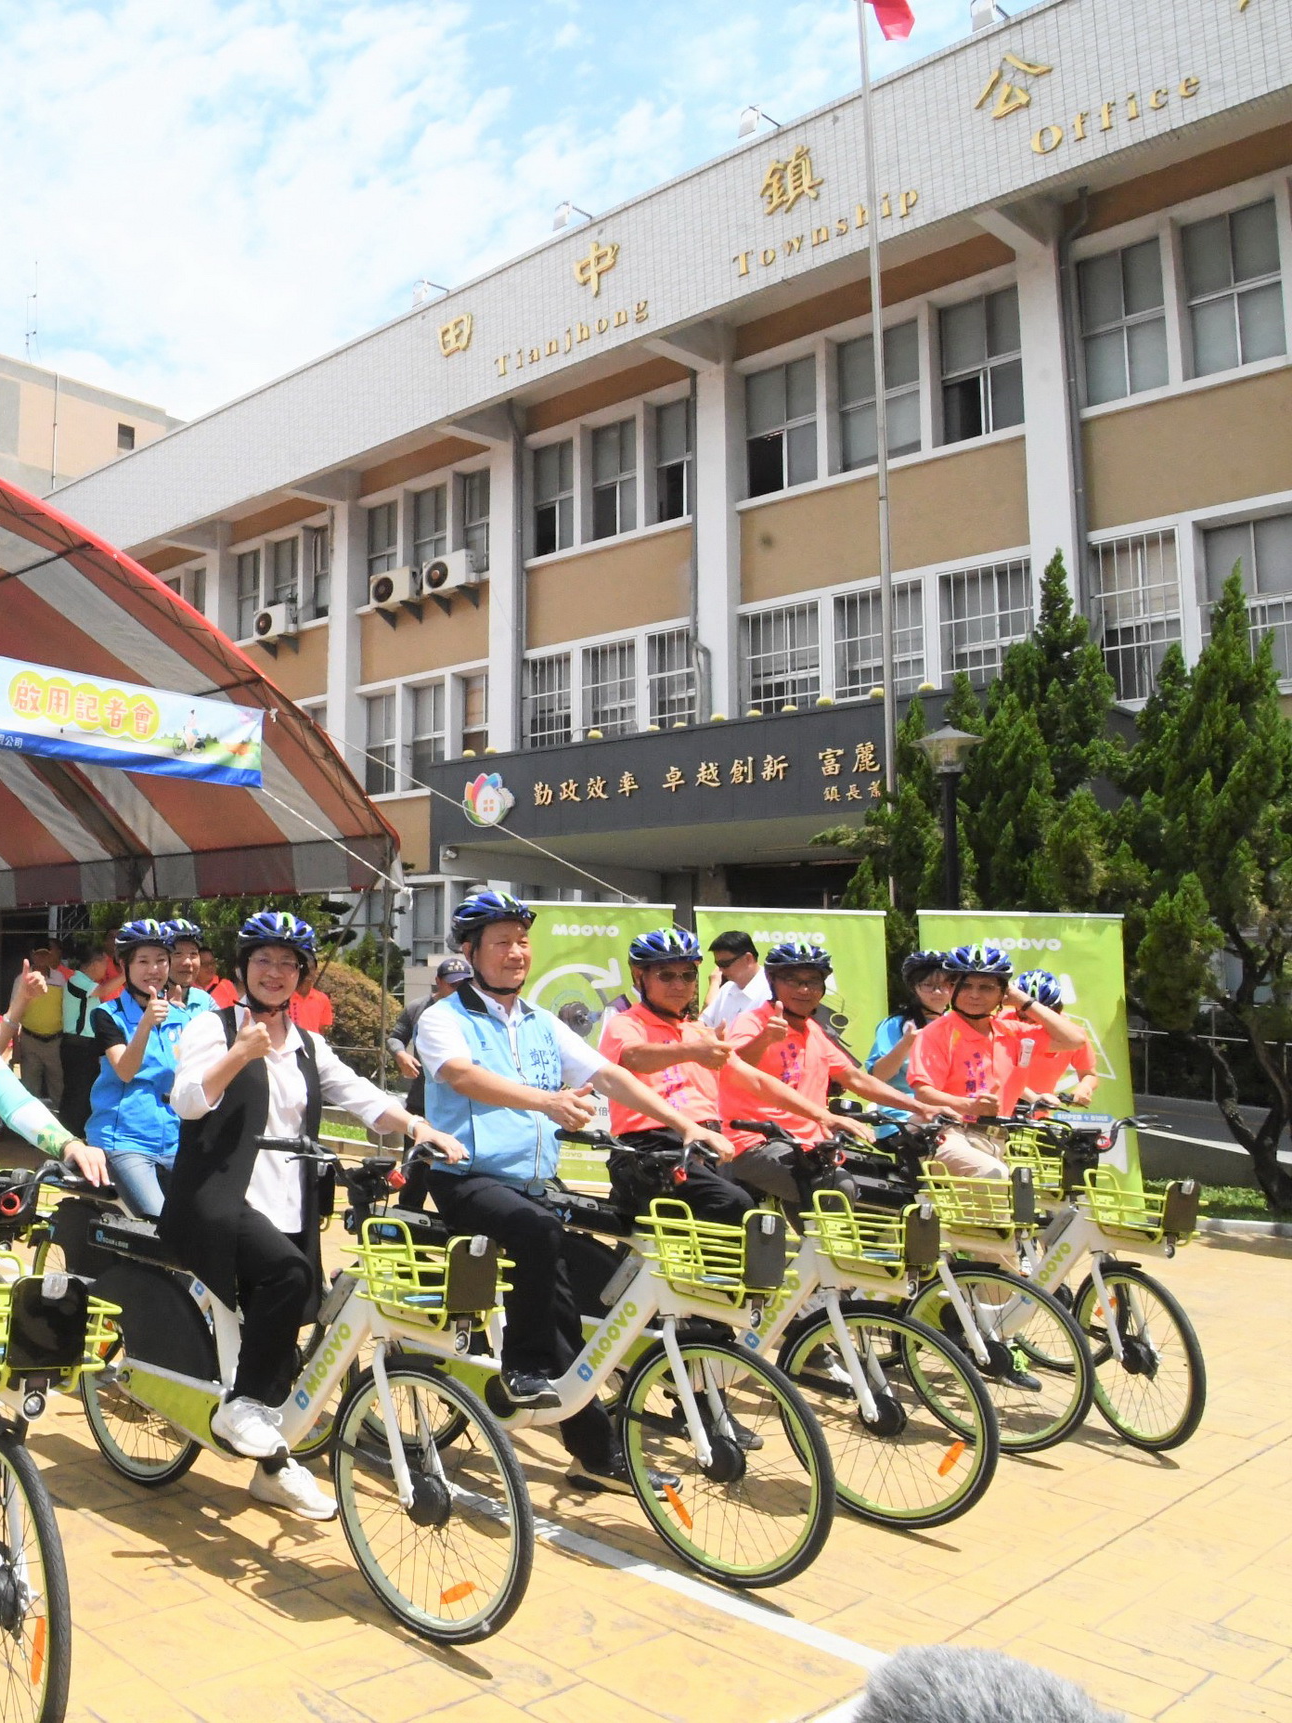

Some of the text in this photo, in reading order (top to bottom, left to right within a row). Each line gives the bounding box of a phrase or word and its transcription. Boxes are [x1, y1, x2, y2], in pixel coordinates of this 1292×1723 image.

[494, 75, 1200, 377] Tianjhong Township Office
[534, 741, 881, 806] 勤政效率 卓越創新 富麗
[551, 923, 619, 937] MOOVO
[753, 930, 826, 944] MOOVO
[983, 937, 1062, 951] MOOVO
[304, 1322, 352, 1398] MOOVO
[591, 1301, 638, 1371] MOOVO
